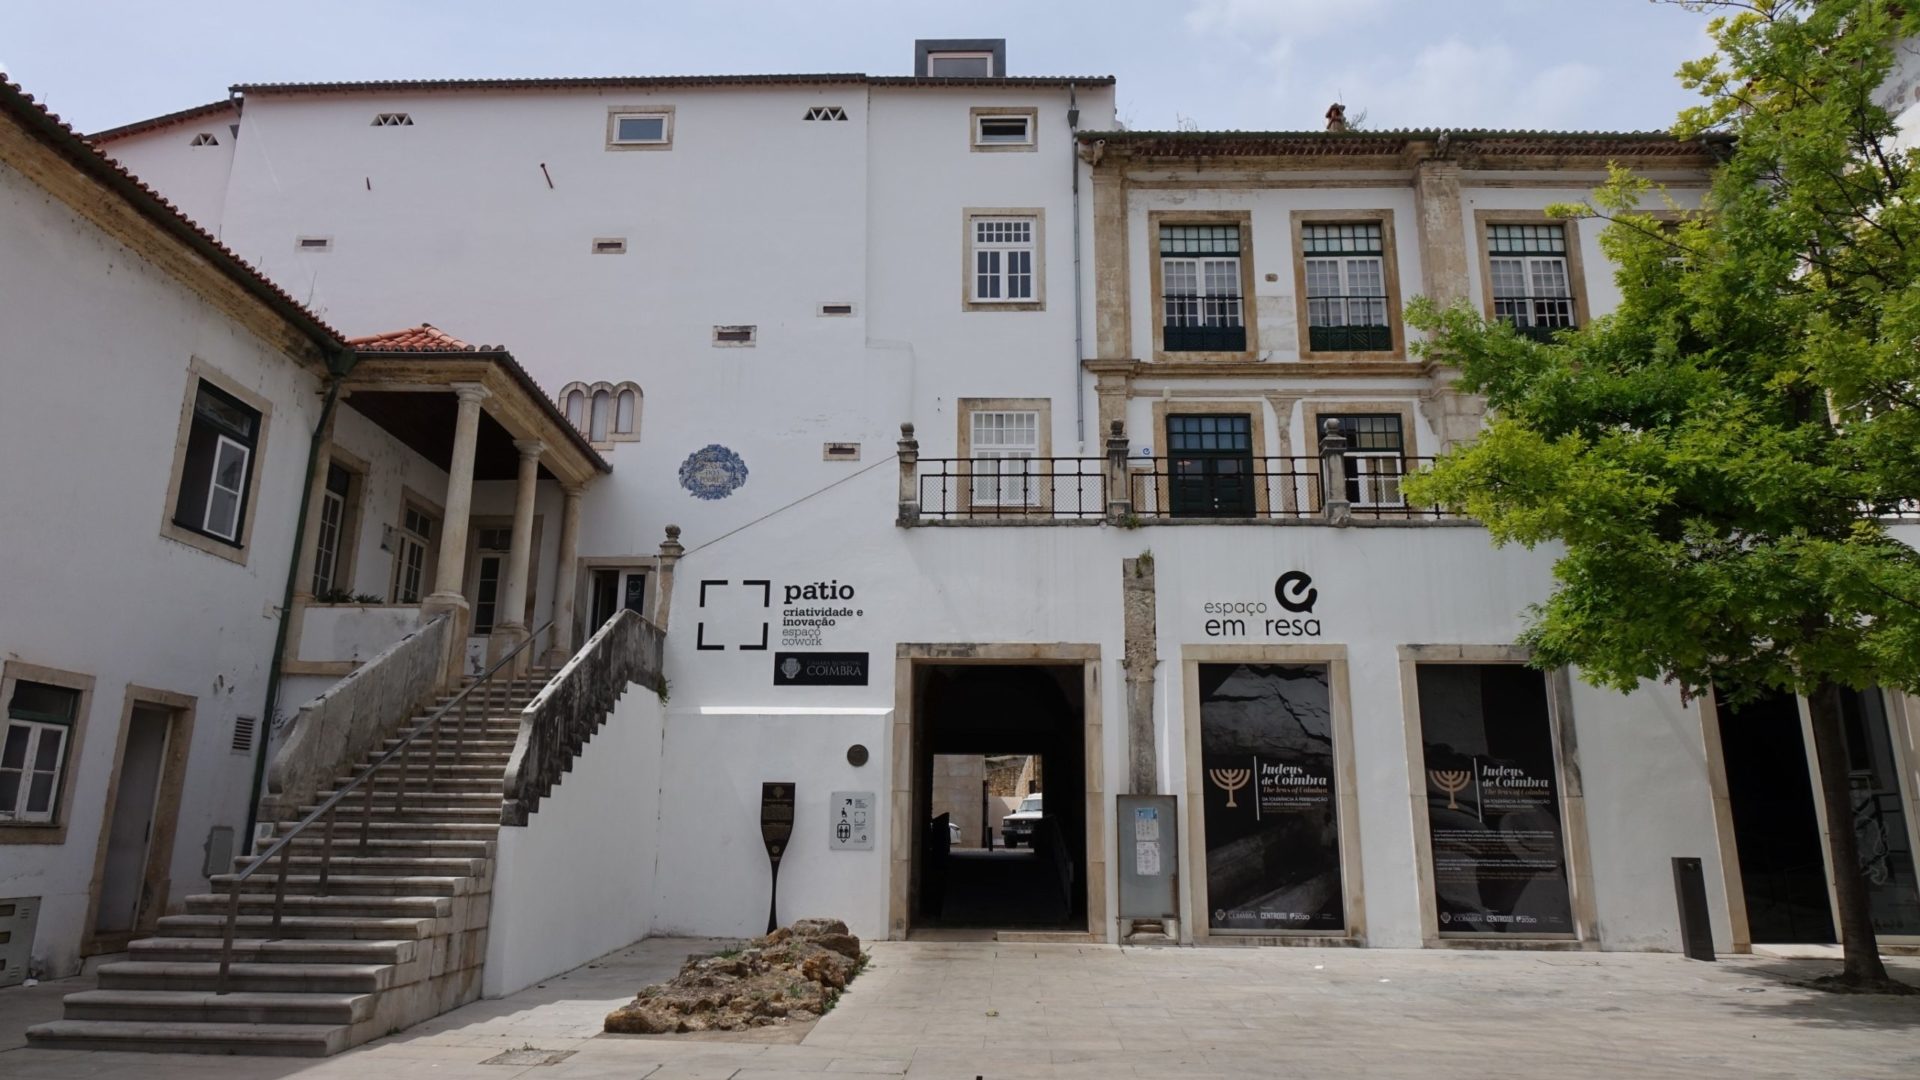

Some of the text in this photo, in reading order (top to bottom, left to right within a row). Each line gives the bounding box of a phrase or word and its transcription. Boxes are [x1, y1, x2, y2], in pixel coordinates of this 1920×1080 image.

[783, 606, 863, 617] criatividade e
[1204, 602, 1267, 616] espaço
[782, 617, 835, 628] inovação
[1205, 618, 1321, 636] emresa
[782, 628, 821, 638] espaço
[782, 636, 822, 646] cowork
[806, 665, 862, 676] COIMBRA
[1261, 763, 1303, 774] Judeus
[1482, 765, 1524, 776] Judeus
[1261, 774, 1327, 785] de Coimbra
[1482, 776, 1548, 787] de Coimbra
